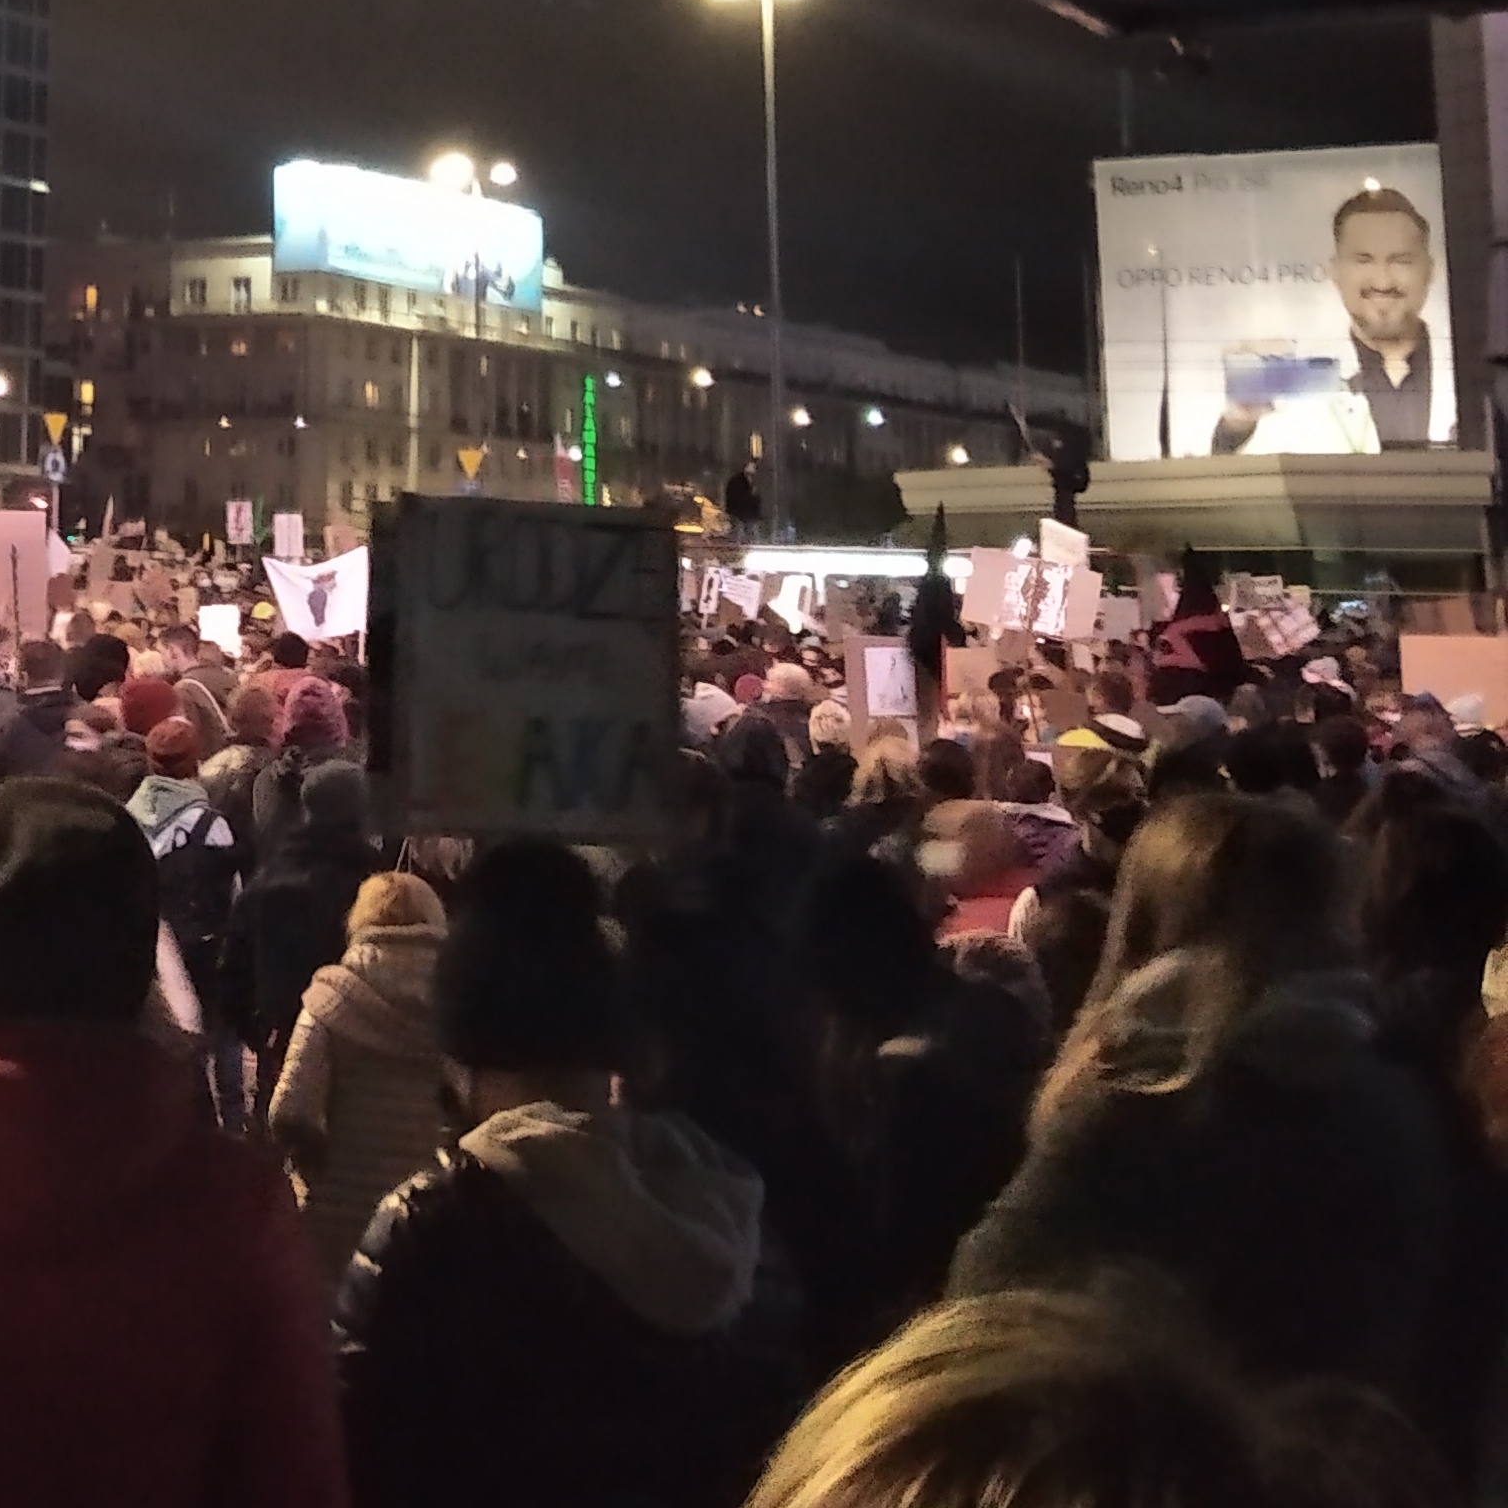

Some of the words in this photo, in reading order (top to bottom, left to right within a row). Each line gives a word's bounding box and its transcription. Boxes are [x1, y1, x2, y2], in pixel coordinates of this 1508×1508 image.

[1110, 174, 1184, 198] Reno4
[1117, 267, 1183, 289] OPPO
[1187, 265, 1269, 286] RENO4
[1277, 263, 1328, 283] PRO
